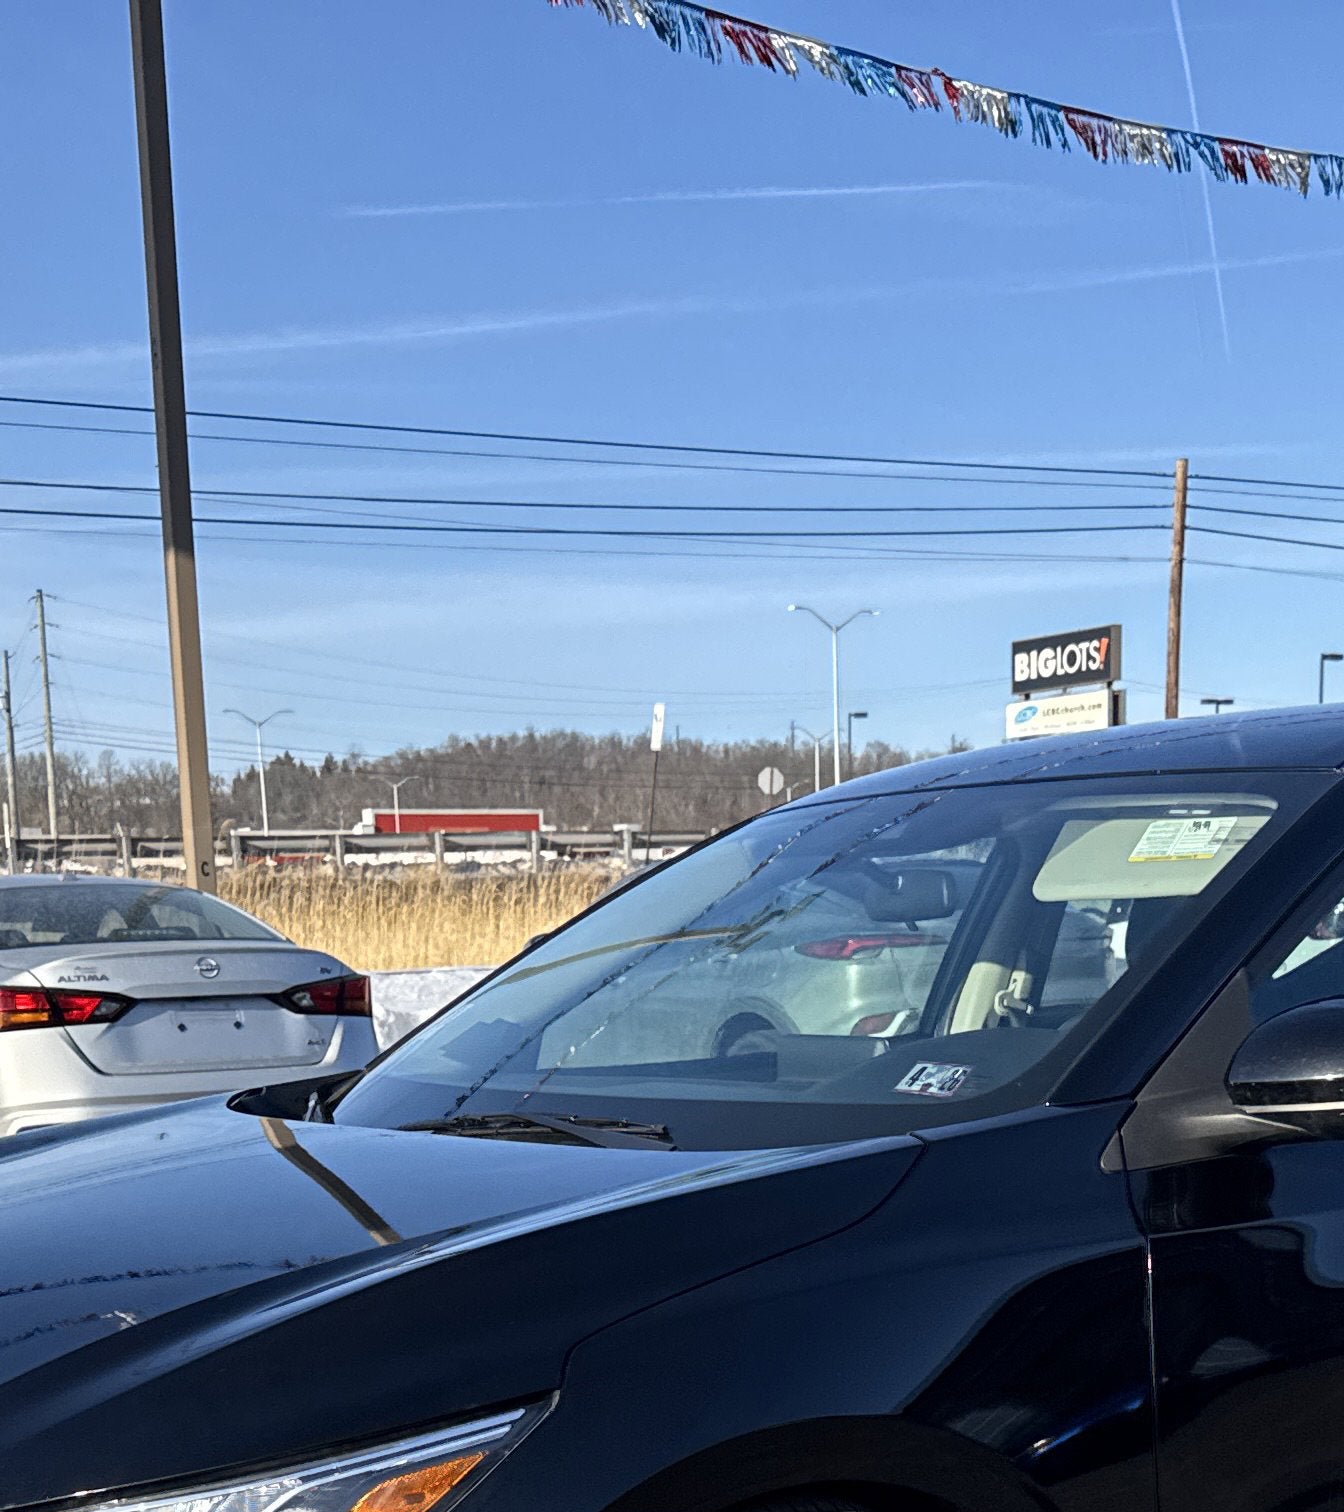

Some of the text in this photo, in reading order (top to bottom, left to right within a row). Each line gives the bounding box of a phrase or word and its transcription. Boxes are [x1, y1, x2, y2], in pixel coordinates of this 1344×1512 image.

[201, 861, 210, 877] C
[57, 974, 110, 983] ALTIMA
[904, 1066, 929, 1088] 4
